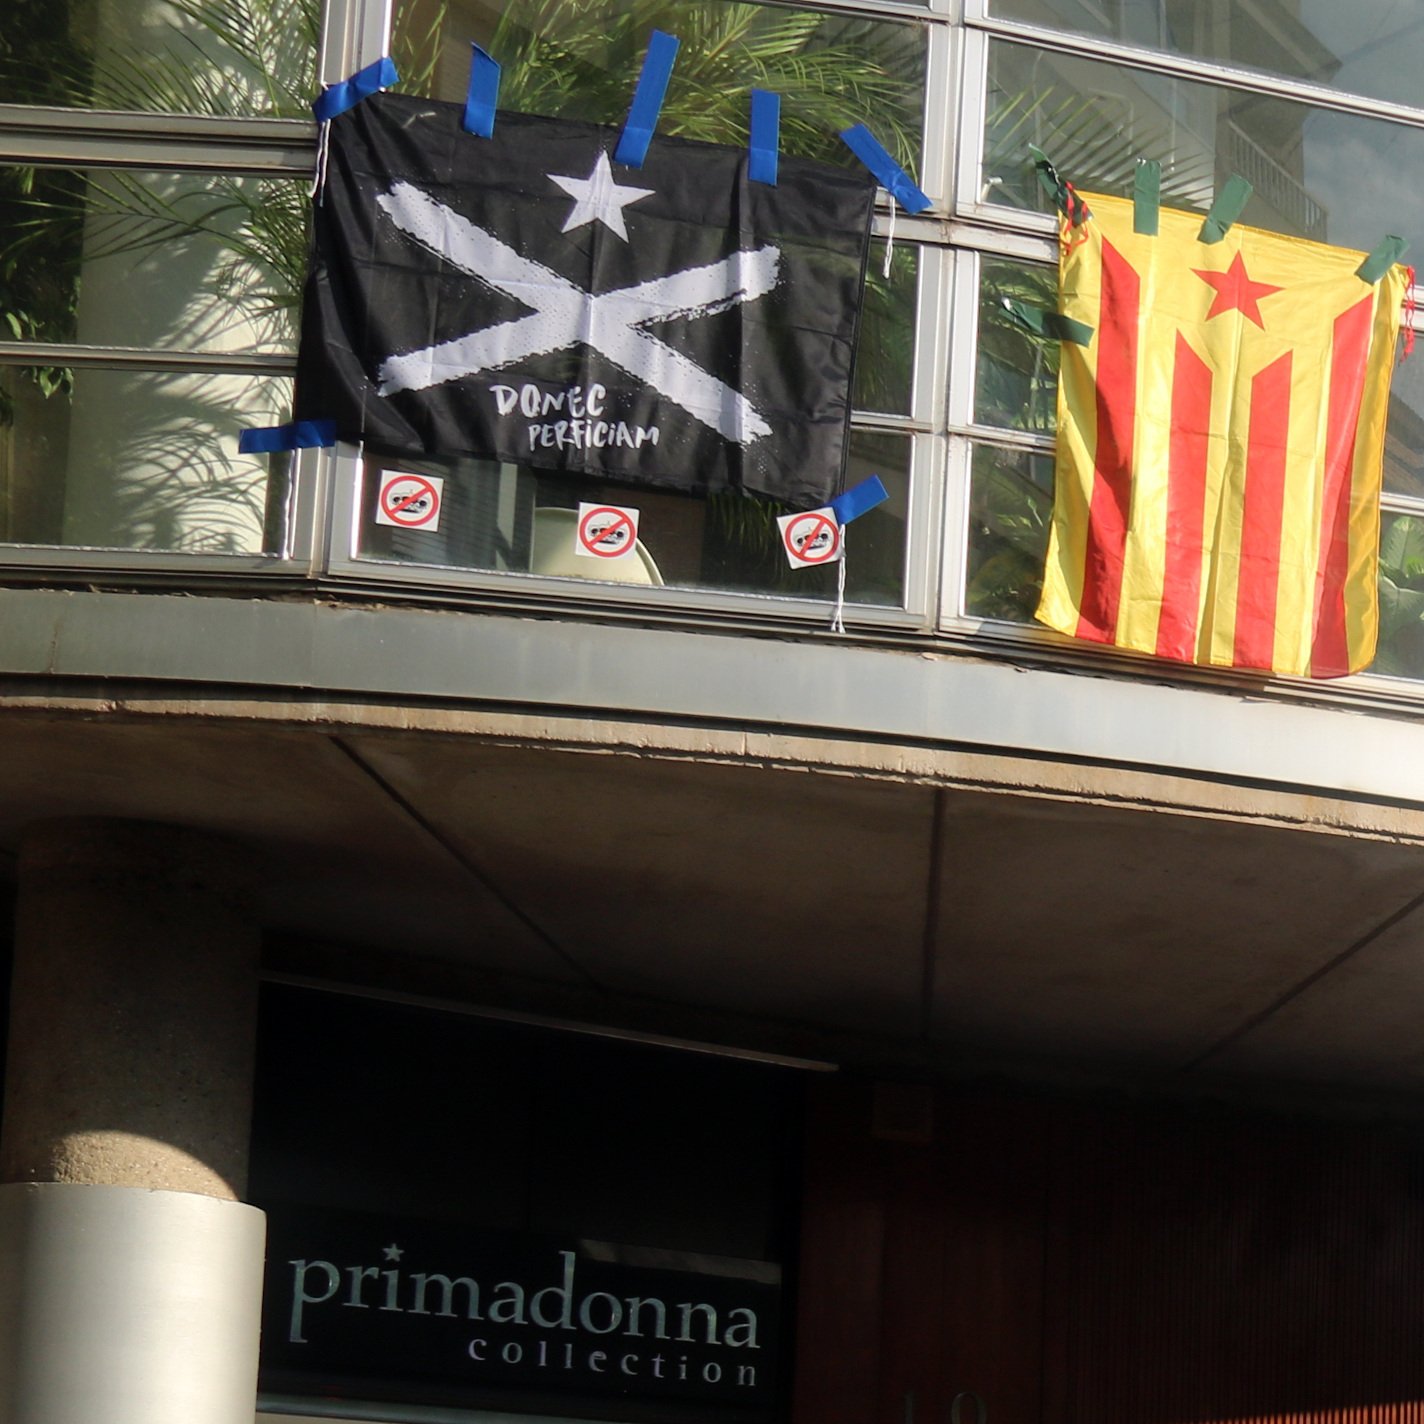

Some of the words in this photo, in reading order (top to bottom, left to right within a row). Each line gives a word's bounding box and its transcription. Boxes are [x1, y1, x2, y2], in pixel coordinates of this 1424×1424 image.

[489, 383, 607, 418] DONEC
[289, 1243, 761, 1349] primadonna
[468, 1338, 757, 1387] collection
